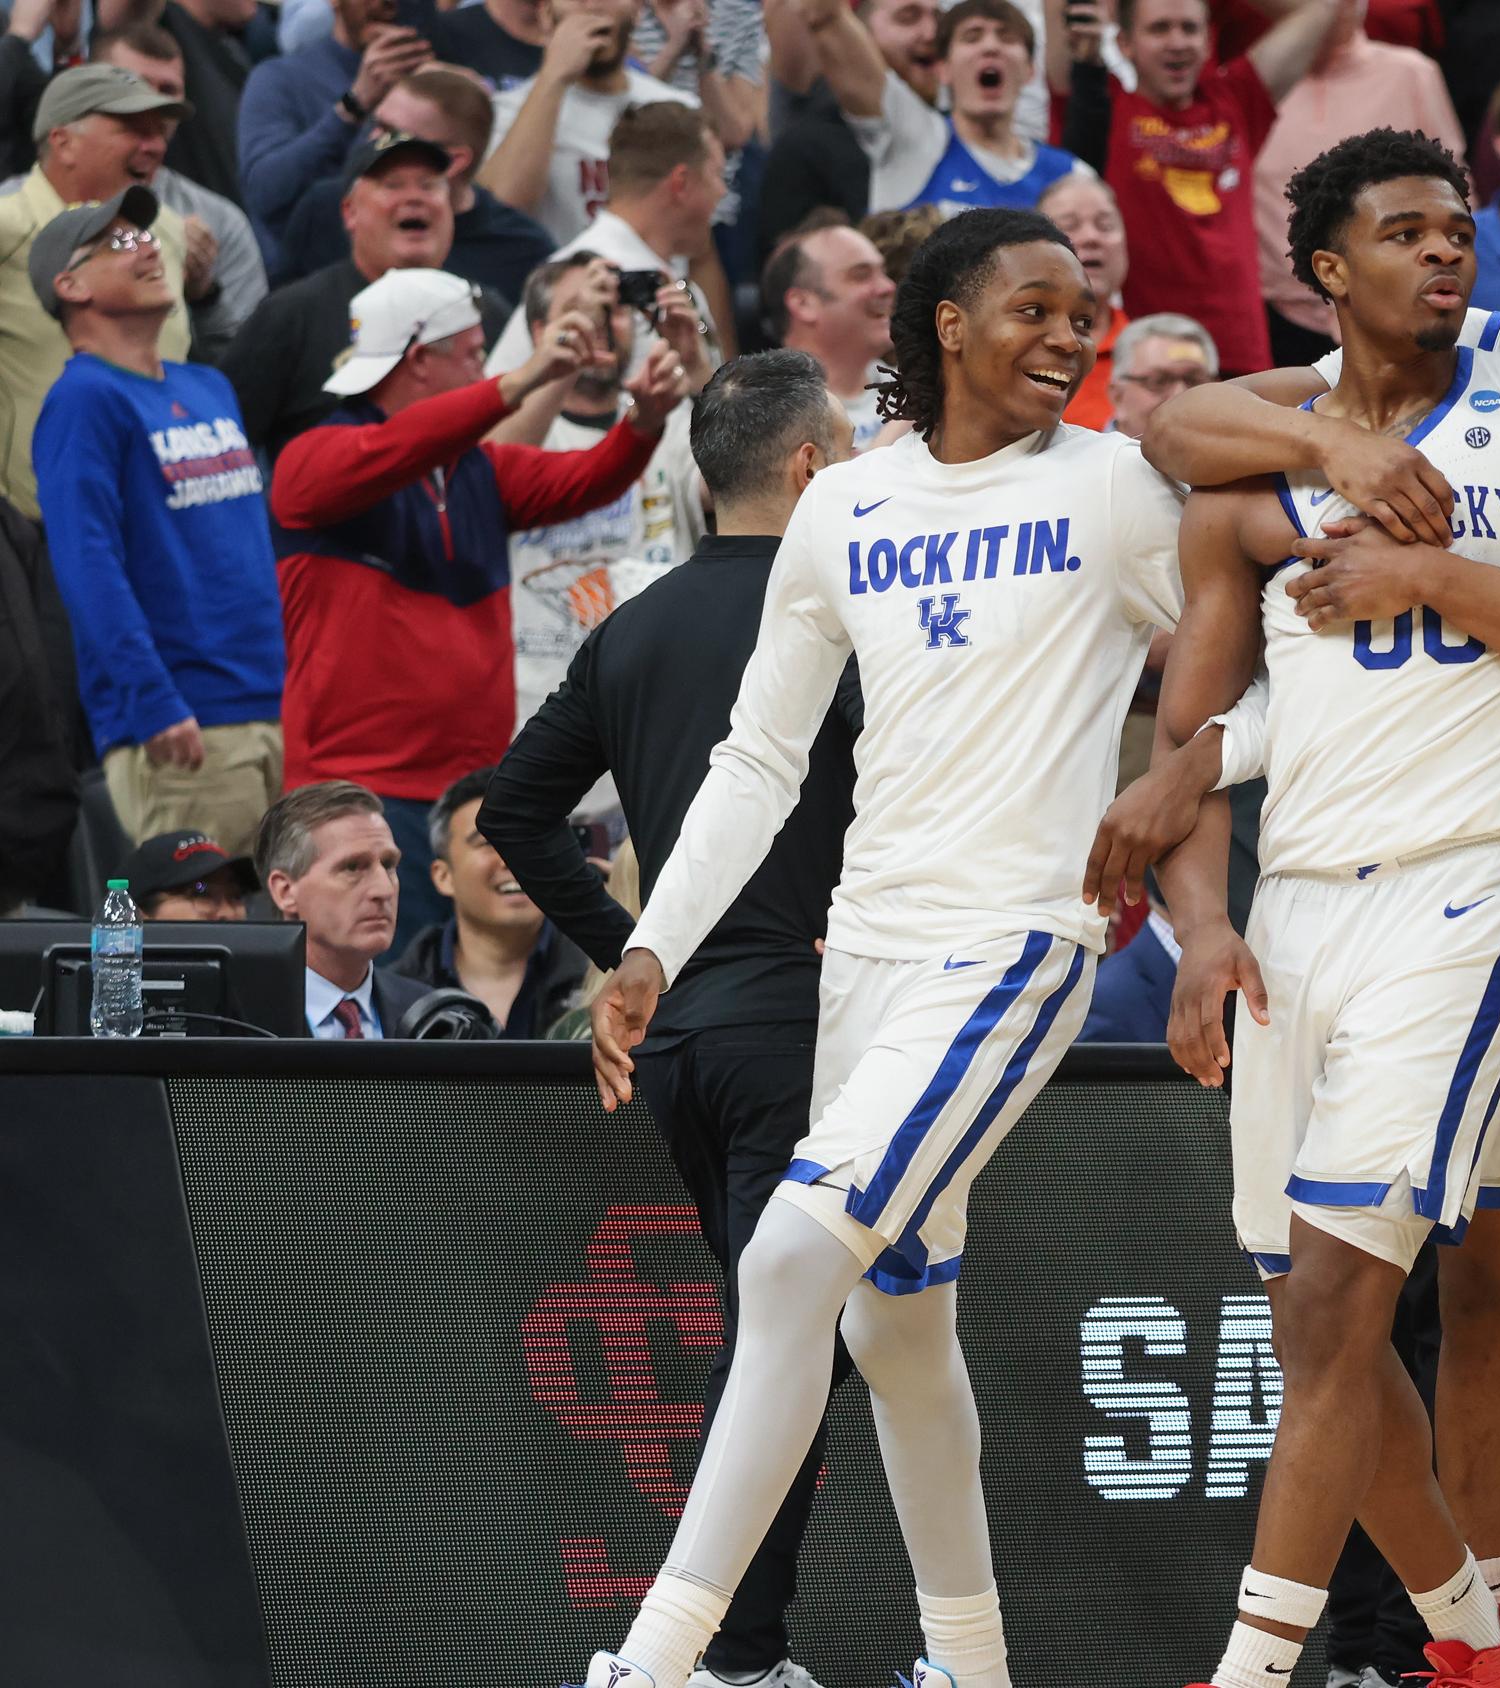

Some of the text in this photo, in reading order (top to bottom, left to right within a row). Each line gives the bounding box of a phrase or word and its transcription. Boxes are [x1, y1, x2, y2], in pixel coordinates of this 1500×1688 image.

[1465, 427, 1491, 448] SEC
[848, 518, 1081, 595] LOCK IT IN.
[916, 592, 972, 651] UK
